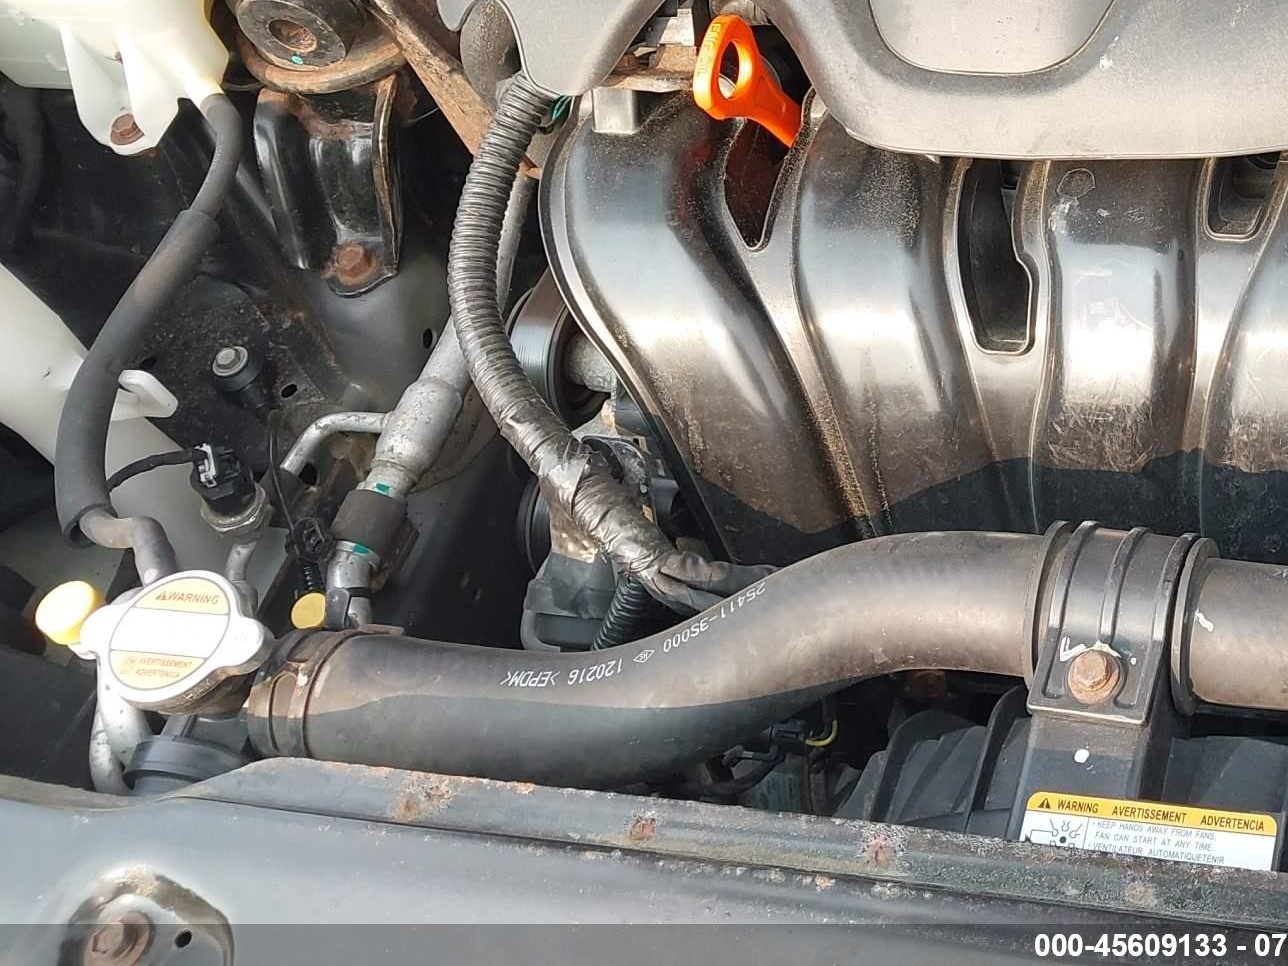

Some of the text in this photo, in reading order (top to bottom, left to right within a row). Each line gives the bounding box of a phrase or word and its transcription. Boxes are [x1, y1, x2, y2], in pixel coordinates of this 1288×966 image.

[167, 592, 220, 605] WARNING
[662, 580, 767, 654] 25411-3S000
[567, 657, 624, 686] 120216
[1057, 799, 1265, 832] WARNING AVERTISSEMENT ADVERTENCIA
[1097, 820, 1117, 830] KEEP
[1119, 823, 1144, 833] HANDS
[1146, 826, 1168, 835] AWAY
[1171, 829, 1193, 838] FROM
[1093, 842, 1143, 855] VENTILATEUR
[1095, 831, 1110, 840] FAN
[1113, 833, 1129, 842] CAN
[1133, 836, 1157, 845] START
[1160, 839, 1170, 847] AT
[1174, 840, 1190, 849] ANY
